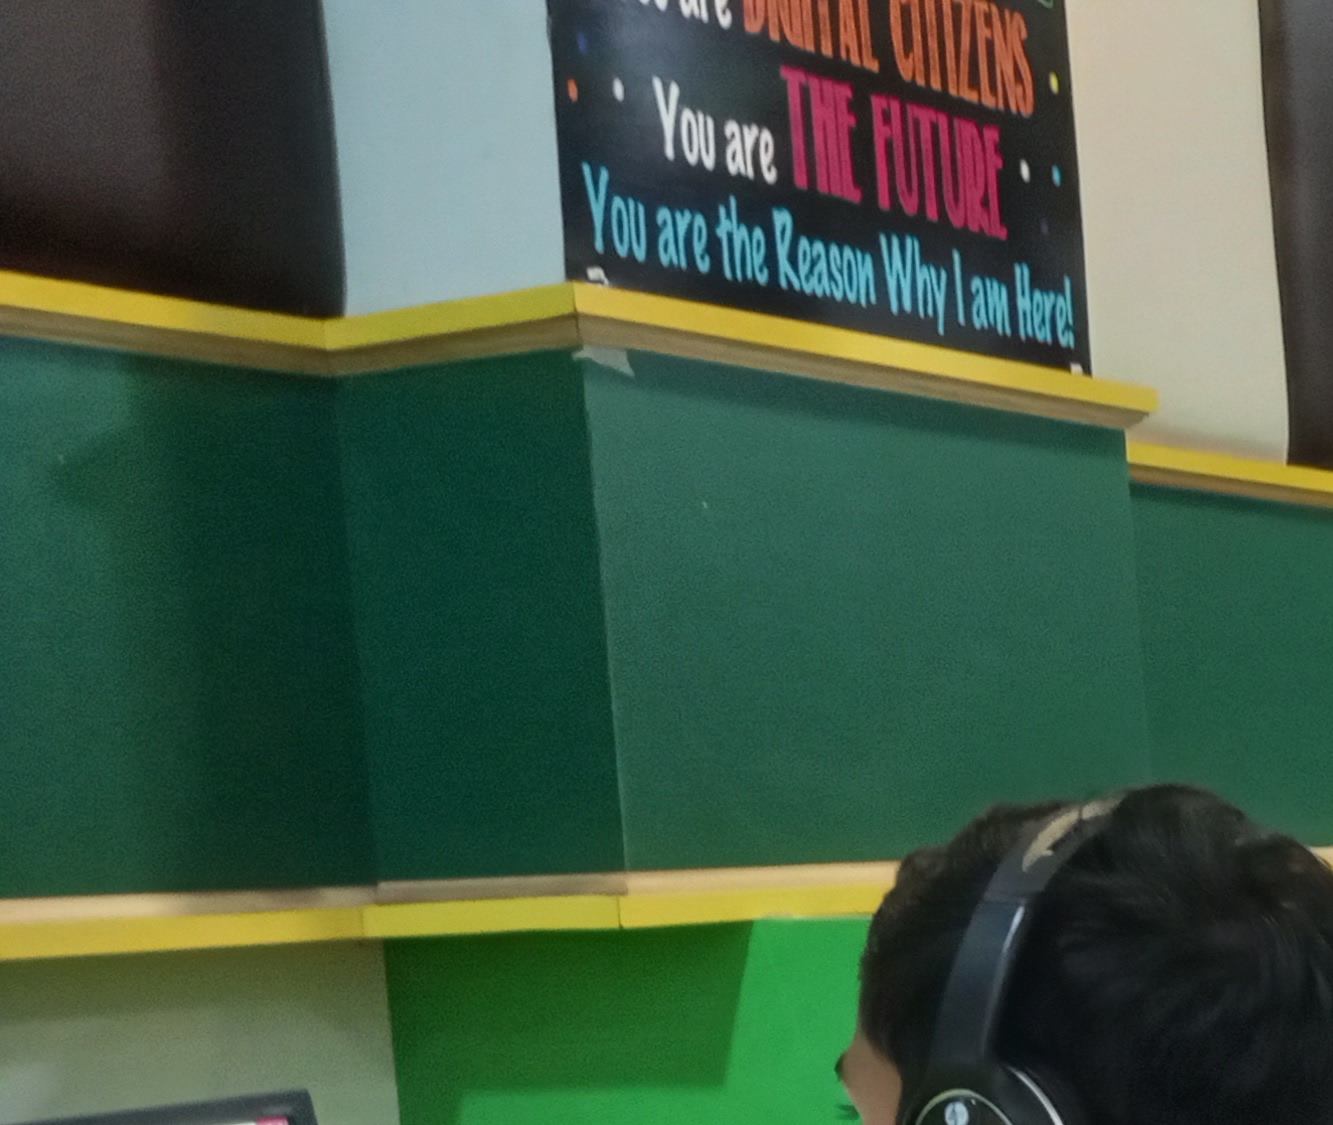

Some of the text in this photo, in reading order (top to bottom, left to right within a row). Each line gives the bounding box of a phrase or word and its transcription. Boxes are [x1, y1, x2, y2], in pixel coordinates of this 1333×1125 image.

[889, 0, 1035, 118] CITIZENS
[652, 64, 1008, 240] You are THE FUTURE
[582, 161, 1076, 348] You are the Reason Why I am Here!
